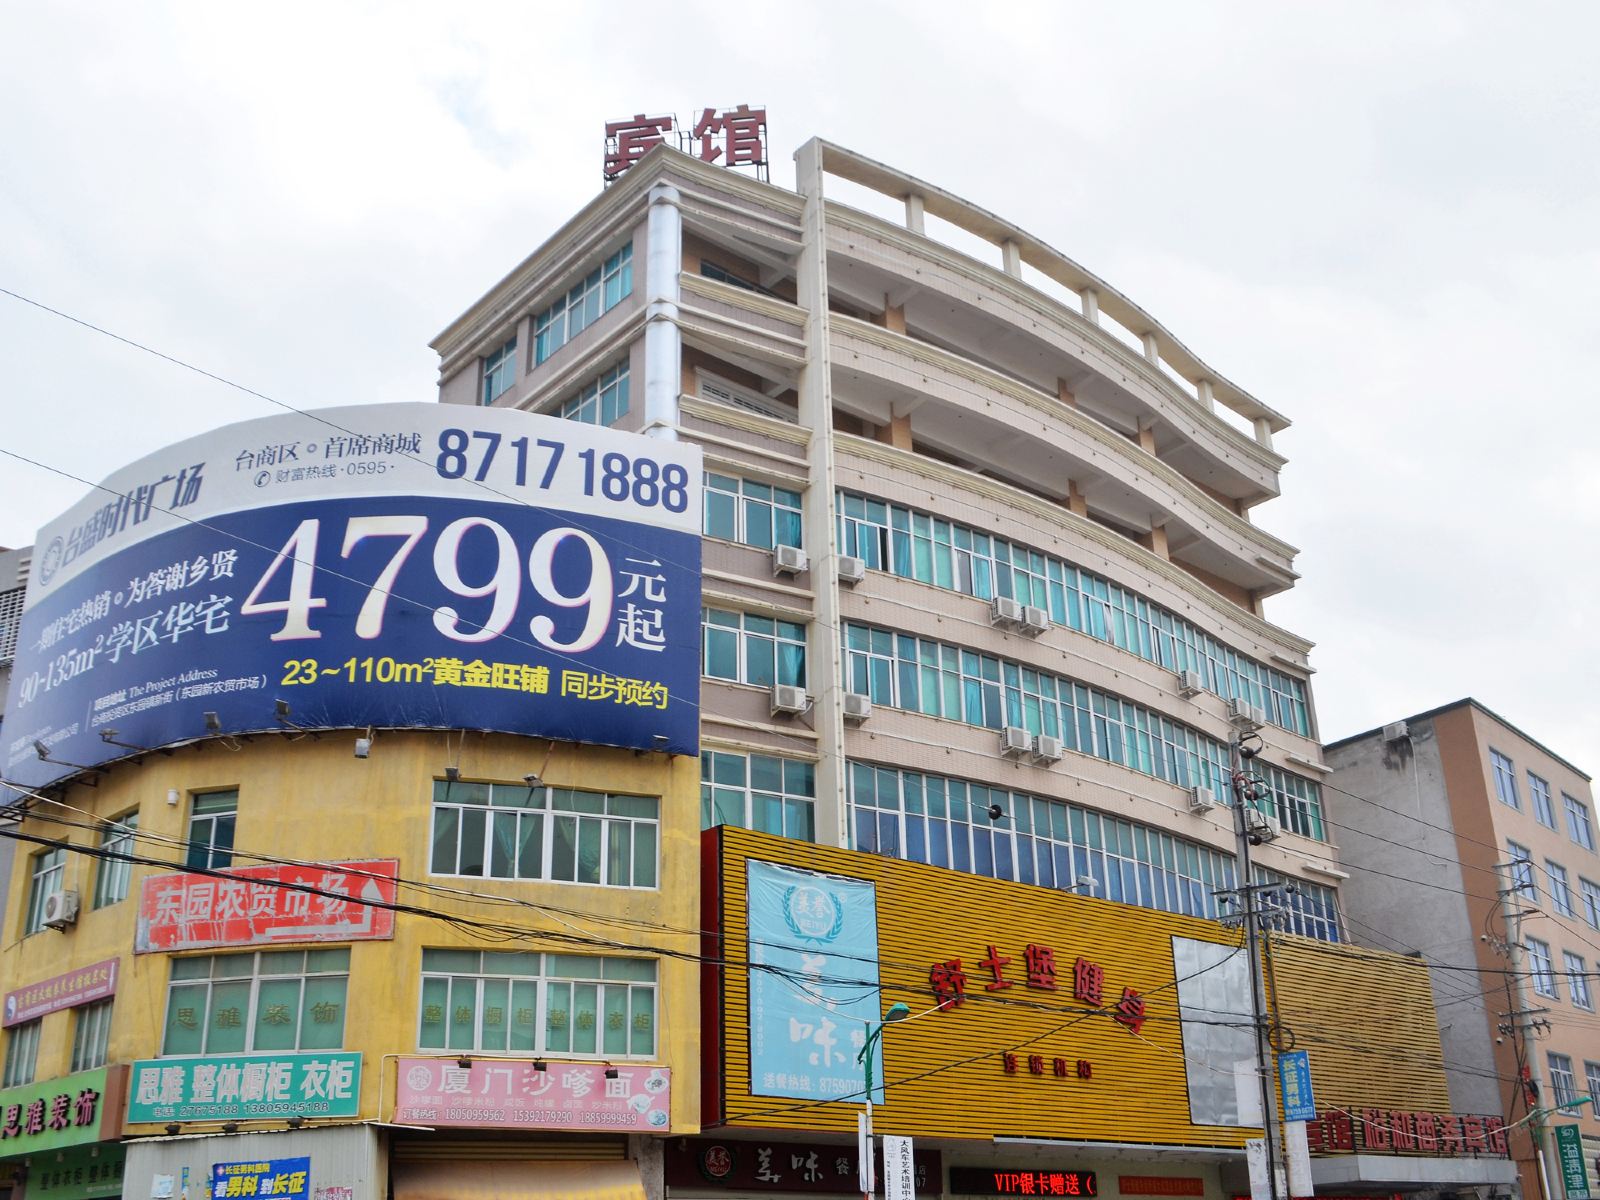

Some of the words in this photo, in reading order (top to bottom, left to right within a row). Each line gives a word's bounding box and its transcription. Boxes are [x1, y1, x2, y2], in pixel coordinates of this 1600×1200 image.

[605, 104, 766, 176] 宾馆
[235, 441, 301, 473] 台商区
[323, 432, 422, 460] 首席商城
[436, 428, 688, 514] 87171888
[124, 550, 239, 608] 为答谢乡贤
[240, 516, 613, 653] 4799
[616, 556, 667, 653] 元起
[129, 686, 145, 699] The
[145, 677, 176, 693] Project
[178, 668, 218, 684] Address
[560, 670, 669, 710] 同步预约
[149, 874, 350, 926] 东园农贸市场
[172, 1001, 340, 1031] 思雅装饰
[136, 1065, 186, 1105] 思雅
[190, 1061, 294, 1104] 整体橱柜
[301, 1059, 355, 1101] 衣柜
[438, 1064, 634, 1099] 厦门沙嗲面
[819, 1077, 867, 1094] 8759070
[0, 1088, 99, 1139] 思雅装饰
[244, 1102, 330, 1115] 13805945188
[214, 1175, 259, 1198] 看男科
[260, 1171, 307, 1195] 到长征
